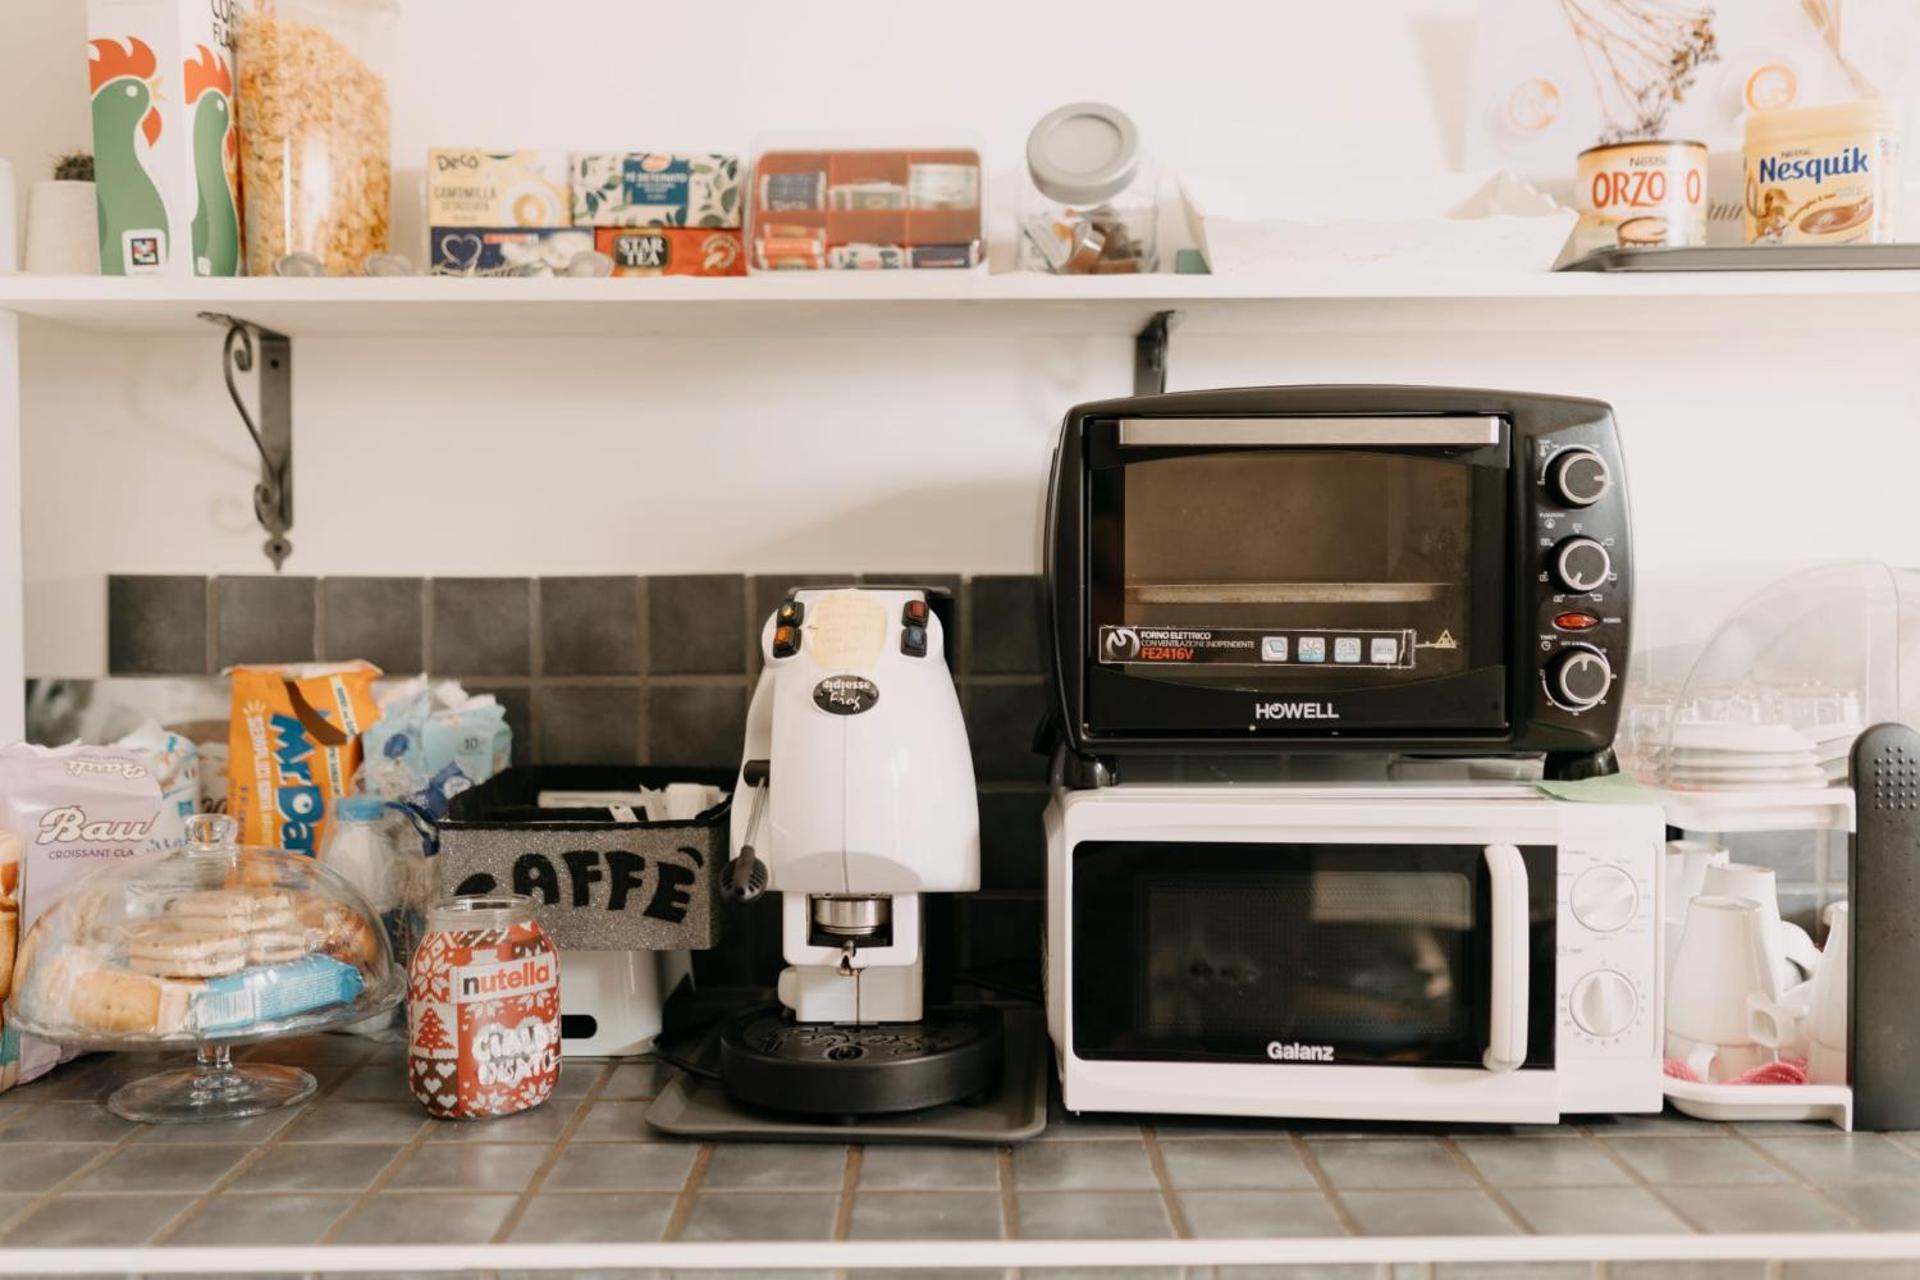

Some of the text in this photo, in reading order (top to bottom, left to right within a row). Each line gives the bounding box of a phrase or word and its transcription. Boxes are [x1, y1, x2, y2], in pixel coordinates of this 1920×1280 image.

[1760, 147, 1868, 184] Nesquik
[1592, 168, 1700, 209] ORZOO
[618, 237, 664, 255] STAR
[624, 248, 660, 266] TEA
[1141, 631, 1212, 641] FORNO ELETTRICO
[1141, 640, 1156, 648] CON
[1157, 640, 1204, 648] VENTILAZIONE
[1141, 647, 1194, 660] FE2416V
[1255, 702, 1340, 719] HOWELL
[464, 737, 479, 751] 10
[49, 849, 110, 861] CROISSANT
[463, 961, 549, 995] nutella
[1266, 1041, 1335, 1061] Galanz
